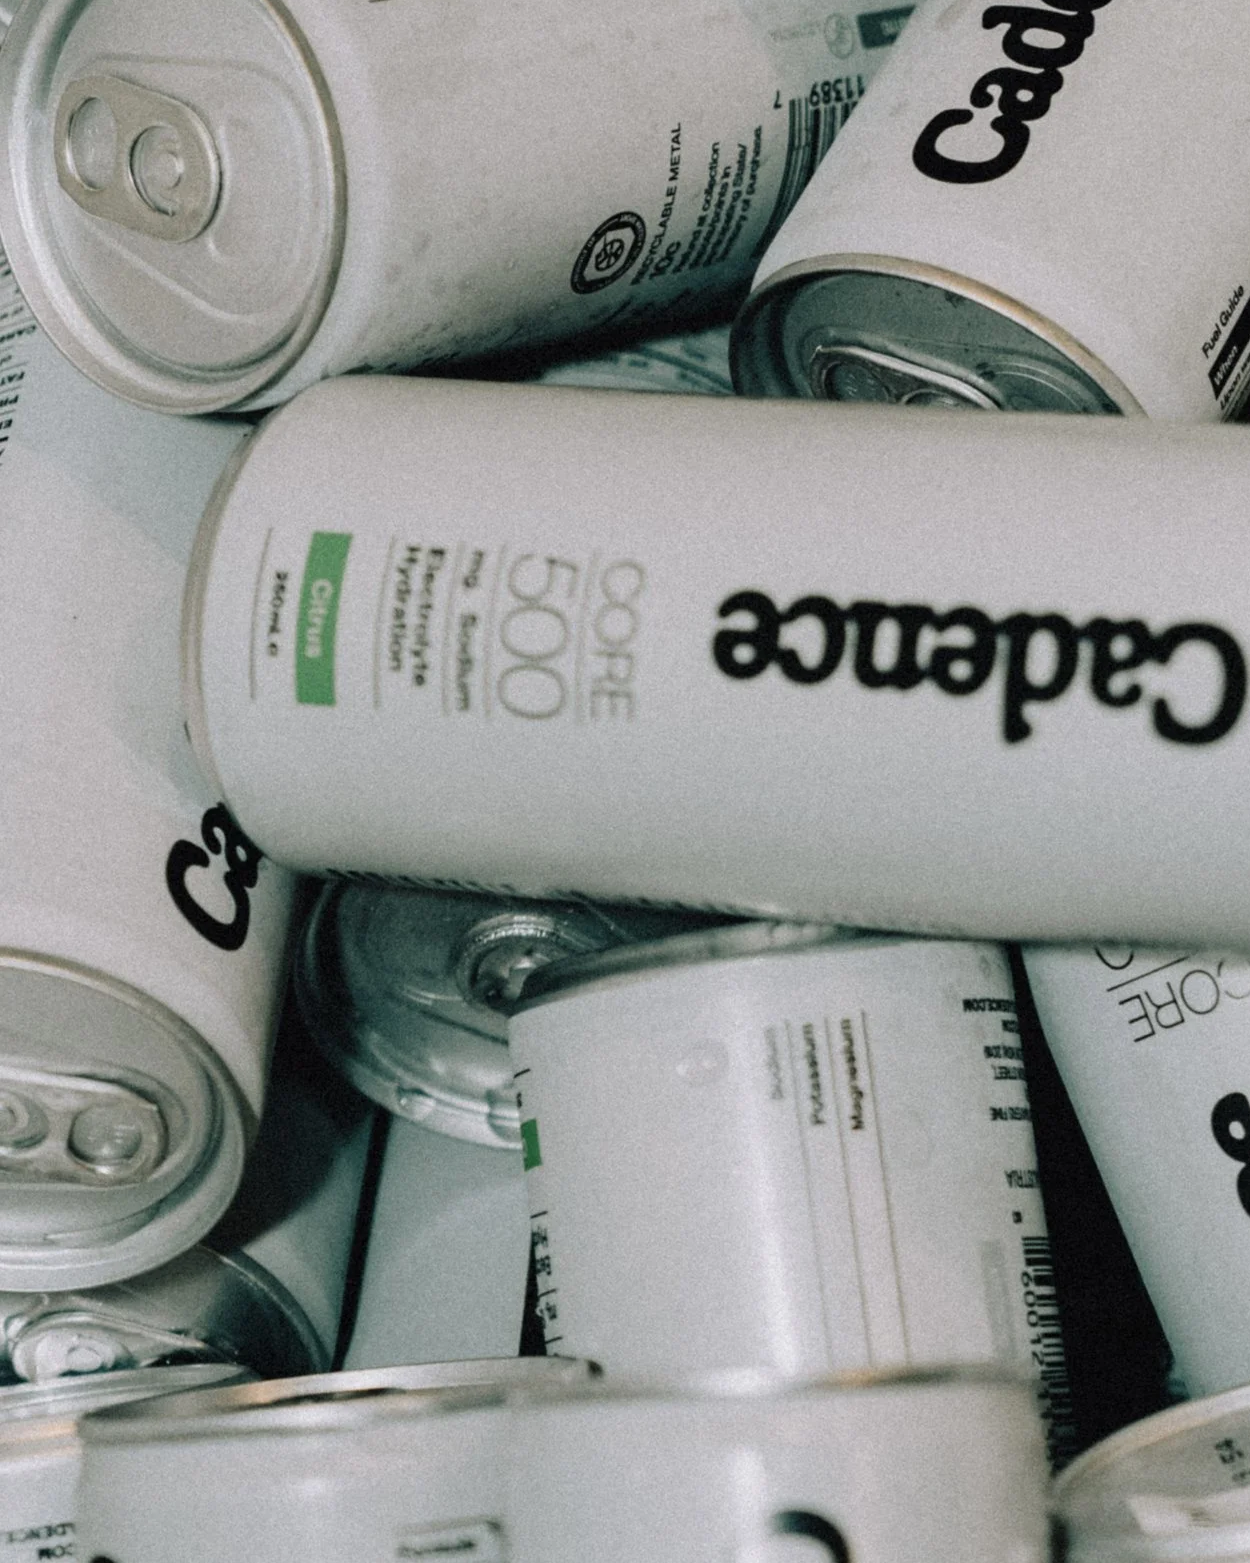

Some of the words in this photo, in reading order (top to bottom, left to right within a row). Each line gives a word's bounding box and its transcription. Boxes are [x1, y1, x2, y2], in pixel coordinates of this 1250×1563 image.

[773, 90, 782, 110] 7
[669, 122, 682, 181] METAL
[702, 141, 720, 213] collection
[1202, 326, 1223, 359] Fuel
[1220, 285, 1244, 327] Guide
[1213, 345, 1239, 386] When
[305, 578, 335, 659] Citrus
[388, 545, 421, 672] Hydration
[410, 547, 446, 687] Electrolyte
[498, 552, 578, 721] 500
[589, 559, 646, 722] CORE
[455, 611, 478, 712] Sodium
[713, 588, 1248, 746] Cadence
[802, 1022, 826, 1126] Potassium
[841, 1018, 864, 1130] Magnesium
